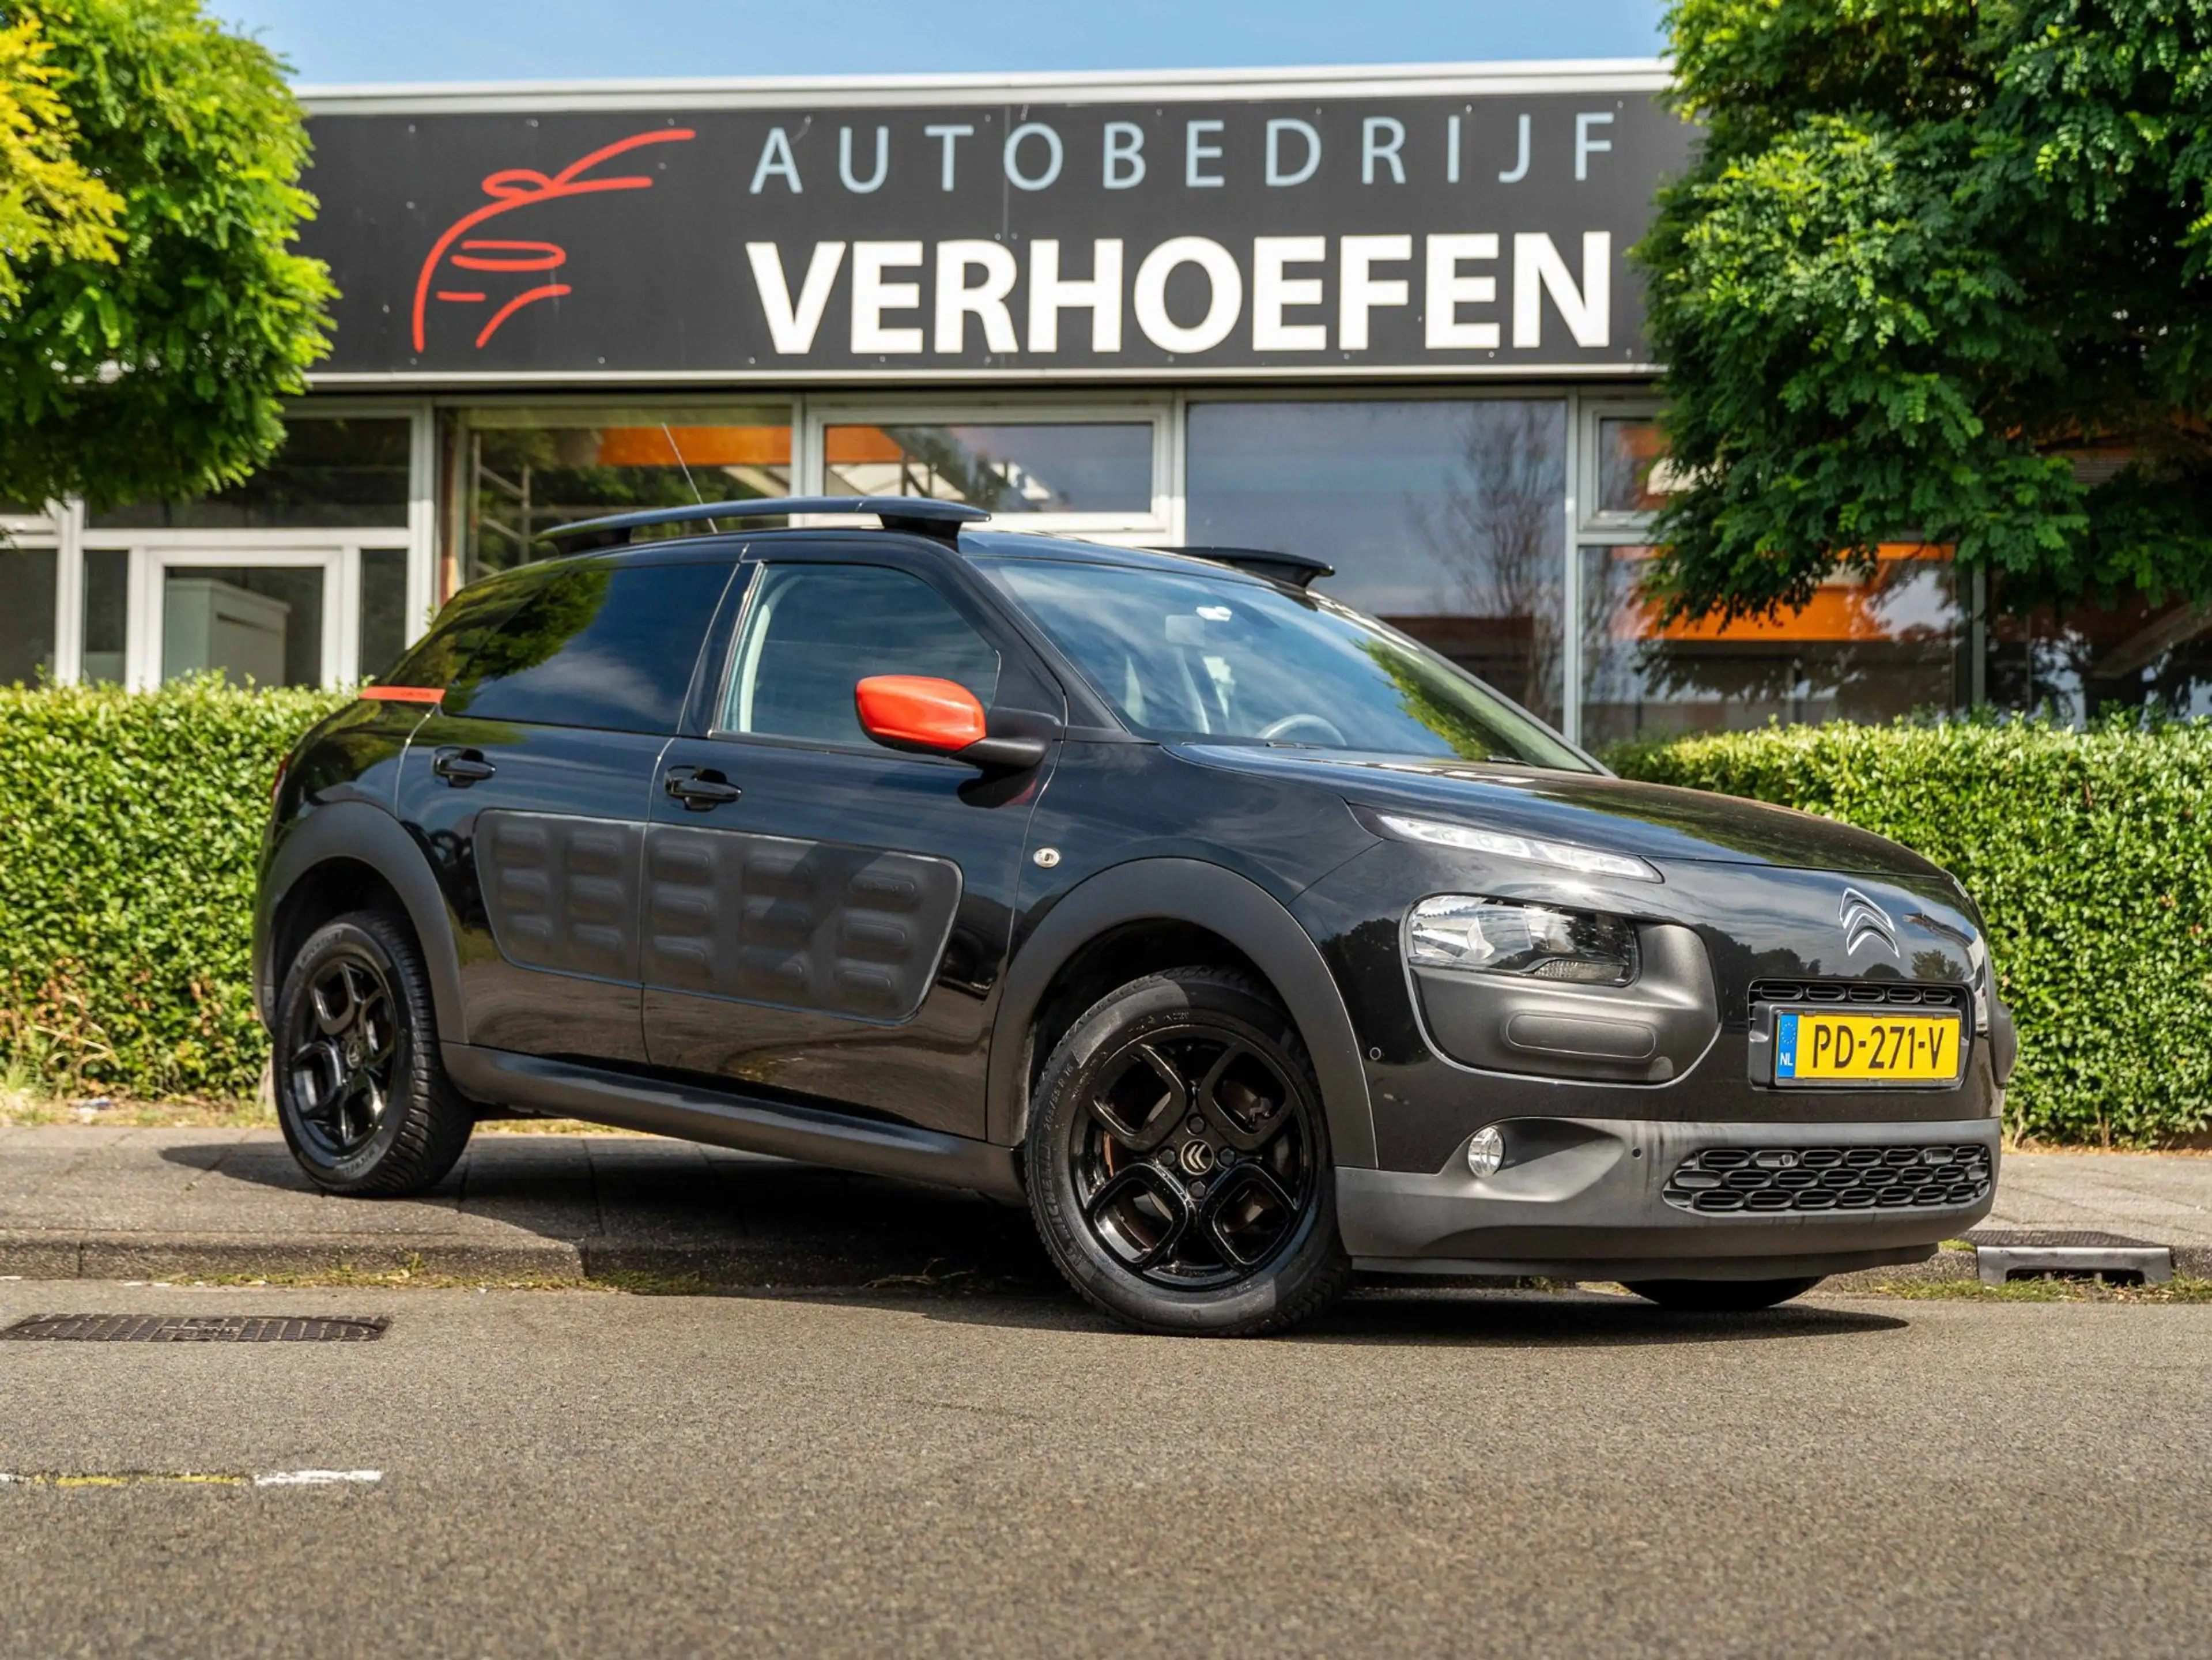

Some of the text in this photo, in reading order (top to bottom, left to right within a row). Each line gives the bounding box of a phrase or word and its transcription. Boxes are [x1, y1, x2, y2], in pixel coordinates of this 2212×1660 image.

[750, 112, 1615, 194] AUTOBEDRIJF
[745, 231, 1611, 354] VERHOEFEN
[1780, 1052, 1793, 1066] NL
[1813, 1024, 1944, 1069] PD-271-V
